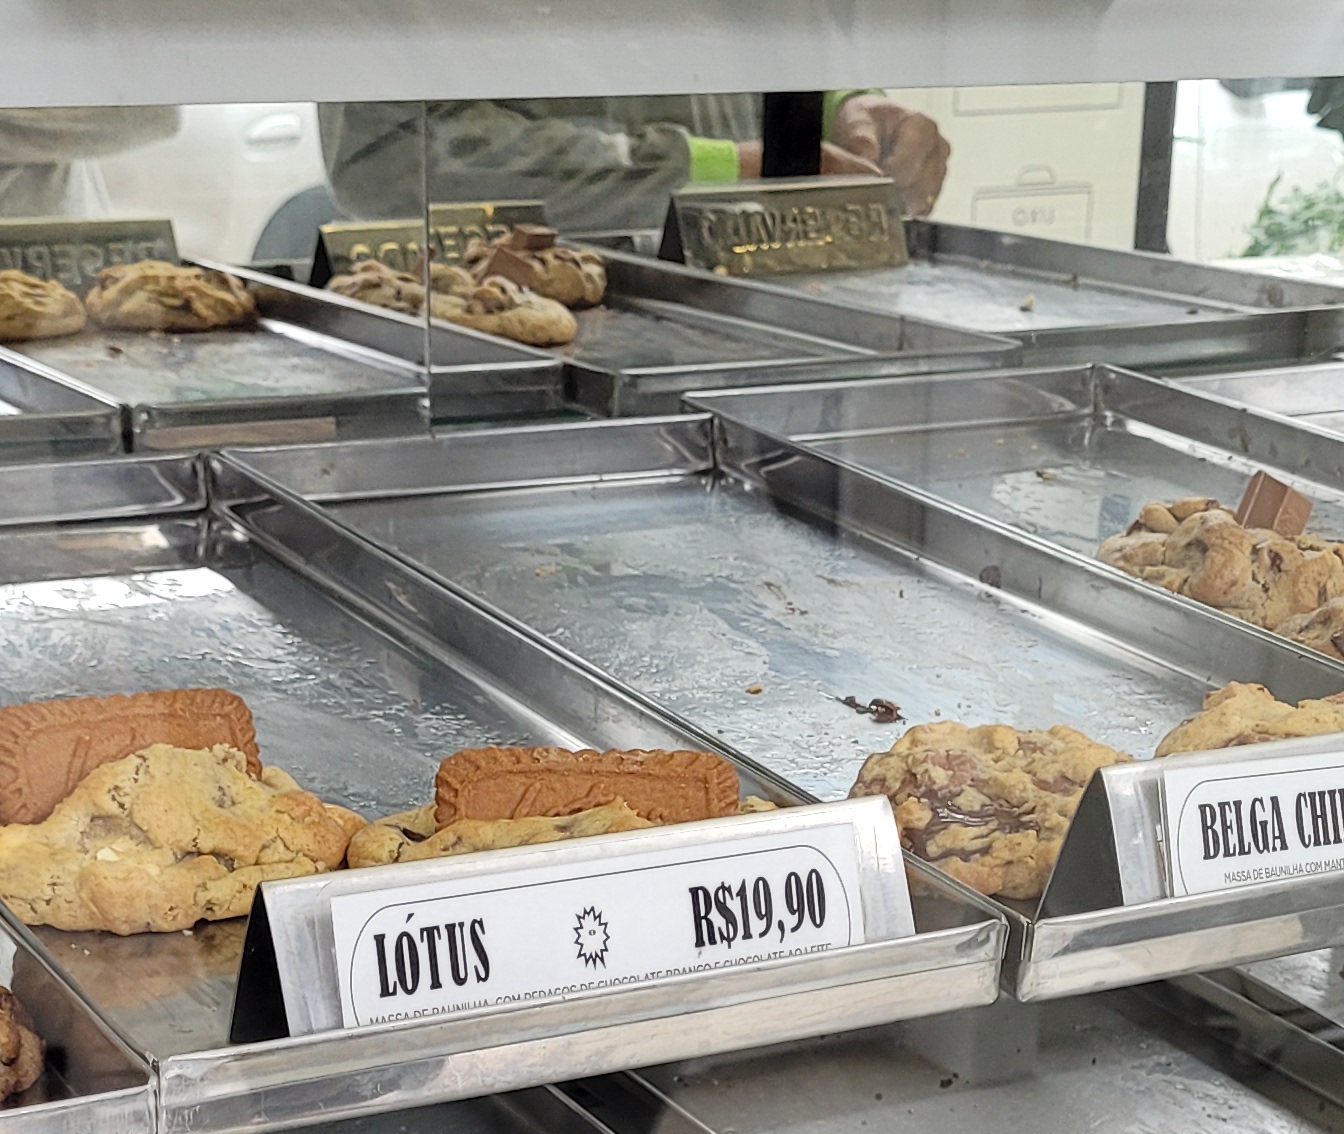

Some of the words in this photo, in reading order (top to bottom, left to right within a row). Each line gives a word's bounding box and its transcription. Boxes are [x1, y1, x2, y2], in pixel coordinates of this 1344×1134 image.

[1198, 794, 1288, 861] BELGA
[1224, 869, 1251, 883] MASSA
[1252, 868, 1263, 880] DE
[1265, 862, 1303, 878] BAUNILHA
[1305, 860, 1322, 873] COM
[373, 913, 489, 998] LÓTUS
[688, 868, 825, 948] R$19,90
